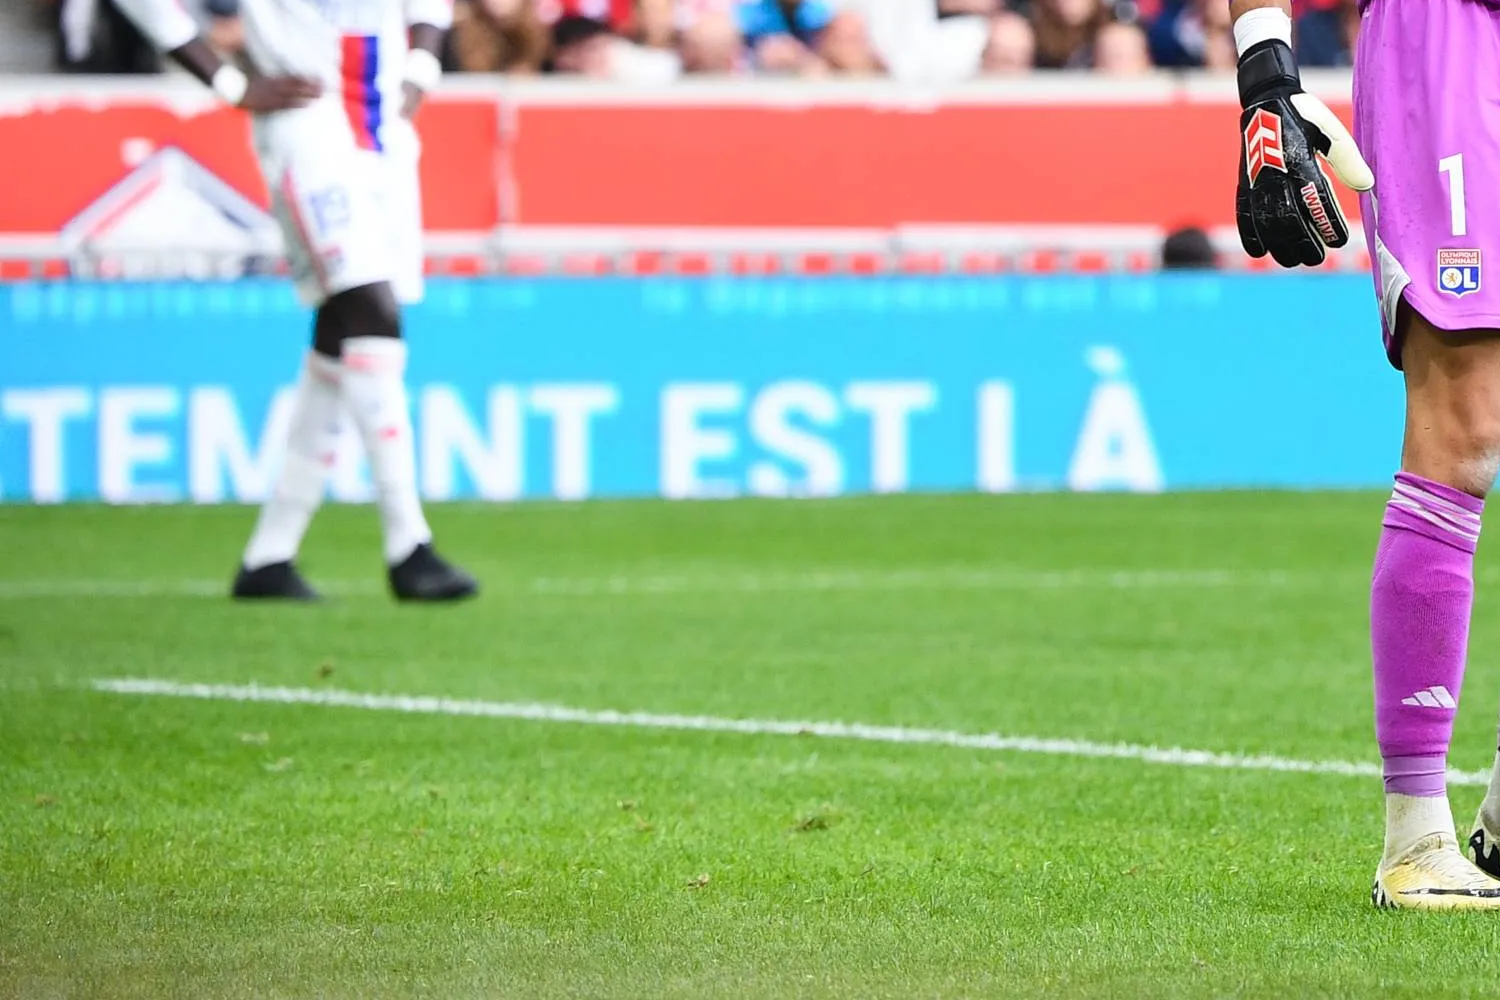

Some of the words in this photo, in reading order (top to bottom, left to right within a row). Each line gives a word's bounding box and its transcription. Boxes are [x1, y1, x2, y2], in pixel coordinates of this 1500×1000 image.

[1301, 181, 1339, 243] TWOFIVE
[1439, 152, 1467, 236] 1
[1442, 268, 1477, 288] OL
[2, 384, 618, 503] TEMNT
[660, 379, 938, 498] EST
